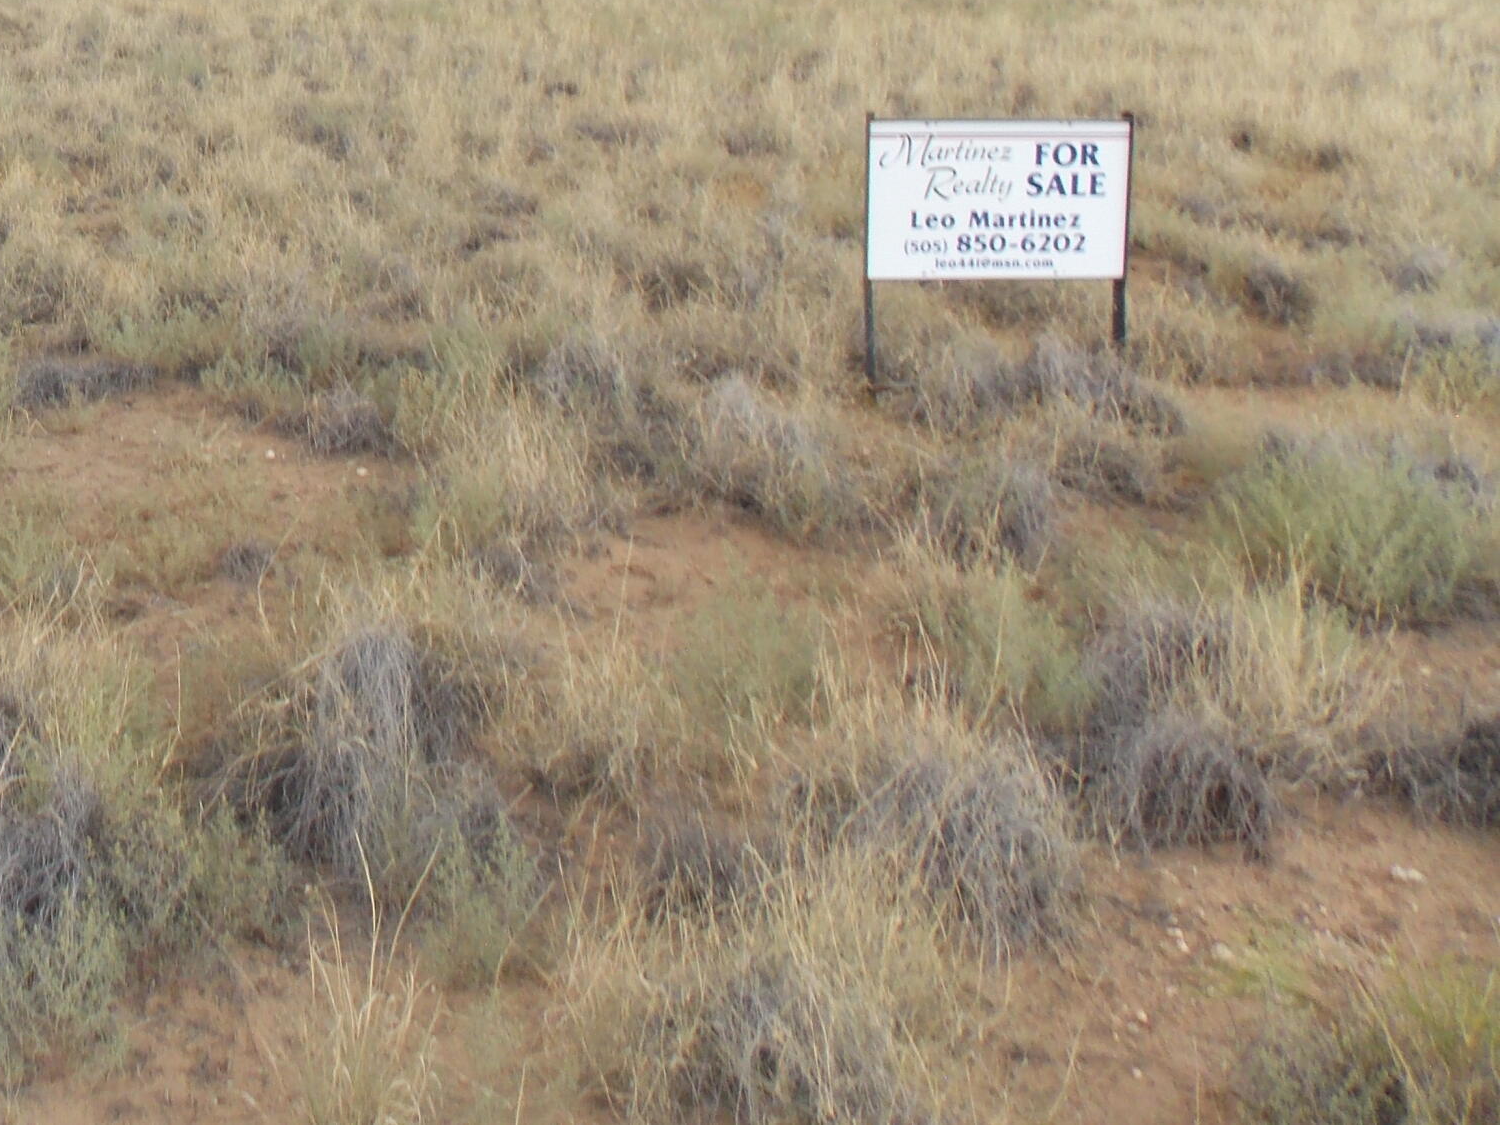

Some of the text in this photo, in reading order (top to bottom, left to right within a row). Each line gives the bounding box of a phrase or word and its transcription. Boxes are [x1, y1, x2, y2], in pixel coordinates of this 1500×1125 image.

[879, 133, 1013, 167] Martinez
[1034, 142, 1101, 166] FOR
[924, 166, 1013, 202] Realty
[1026, 172, 1106, 197] SALE
[910, 209, 1082, 230] Leo Martinez
[904, 234, 1086, 255] (505) 850-6202
